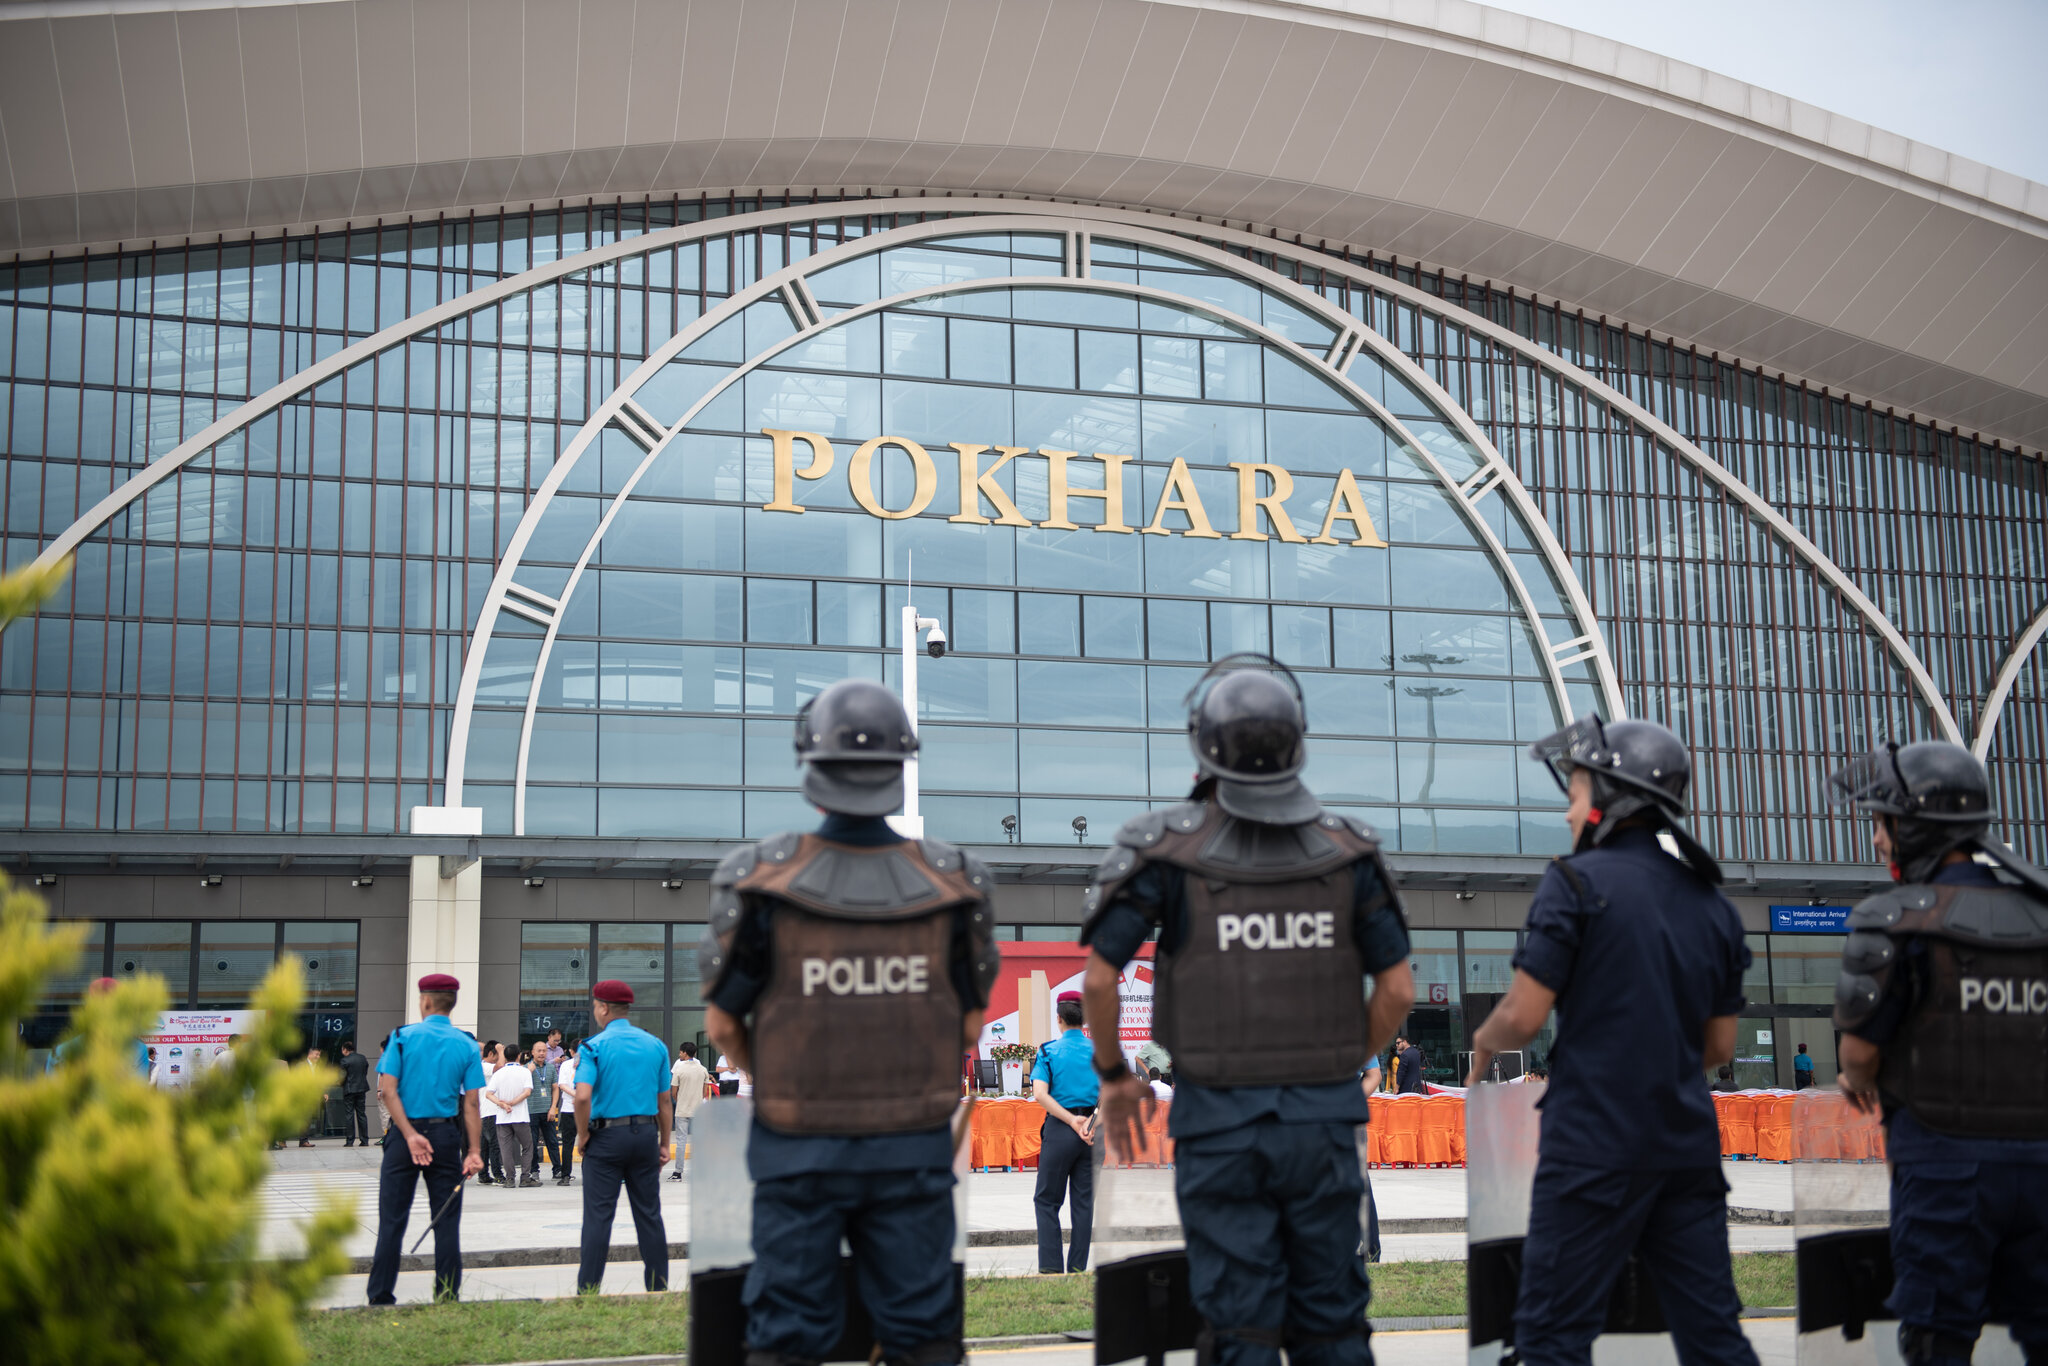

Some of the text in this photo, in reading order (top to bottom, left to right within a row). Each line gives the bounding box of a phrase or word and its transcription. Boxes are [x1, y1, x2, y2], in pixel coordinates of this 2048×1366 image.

[762, 427, 1388, 548] POKHARA
[1793, 910, 1826, 918] International
[1217, 911, 1334, 951] POLICE
[802, 956, 928, 996] POLICE
[1432, 985, 1445, 1002] 6
[1960, 978, 2048, 1013] POLIC
[324, 1018, 343, 1032] 13
[534, 1016, 551, 1029] 15
